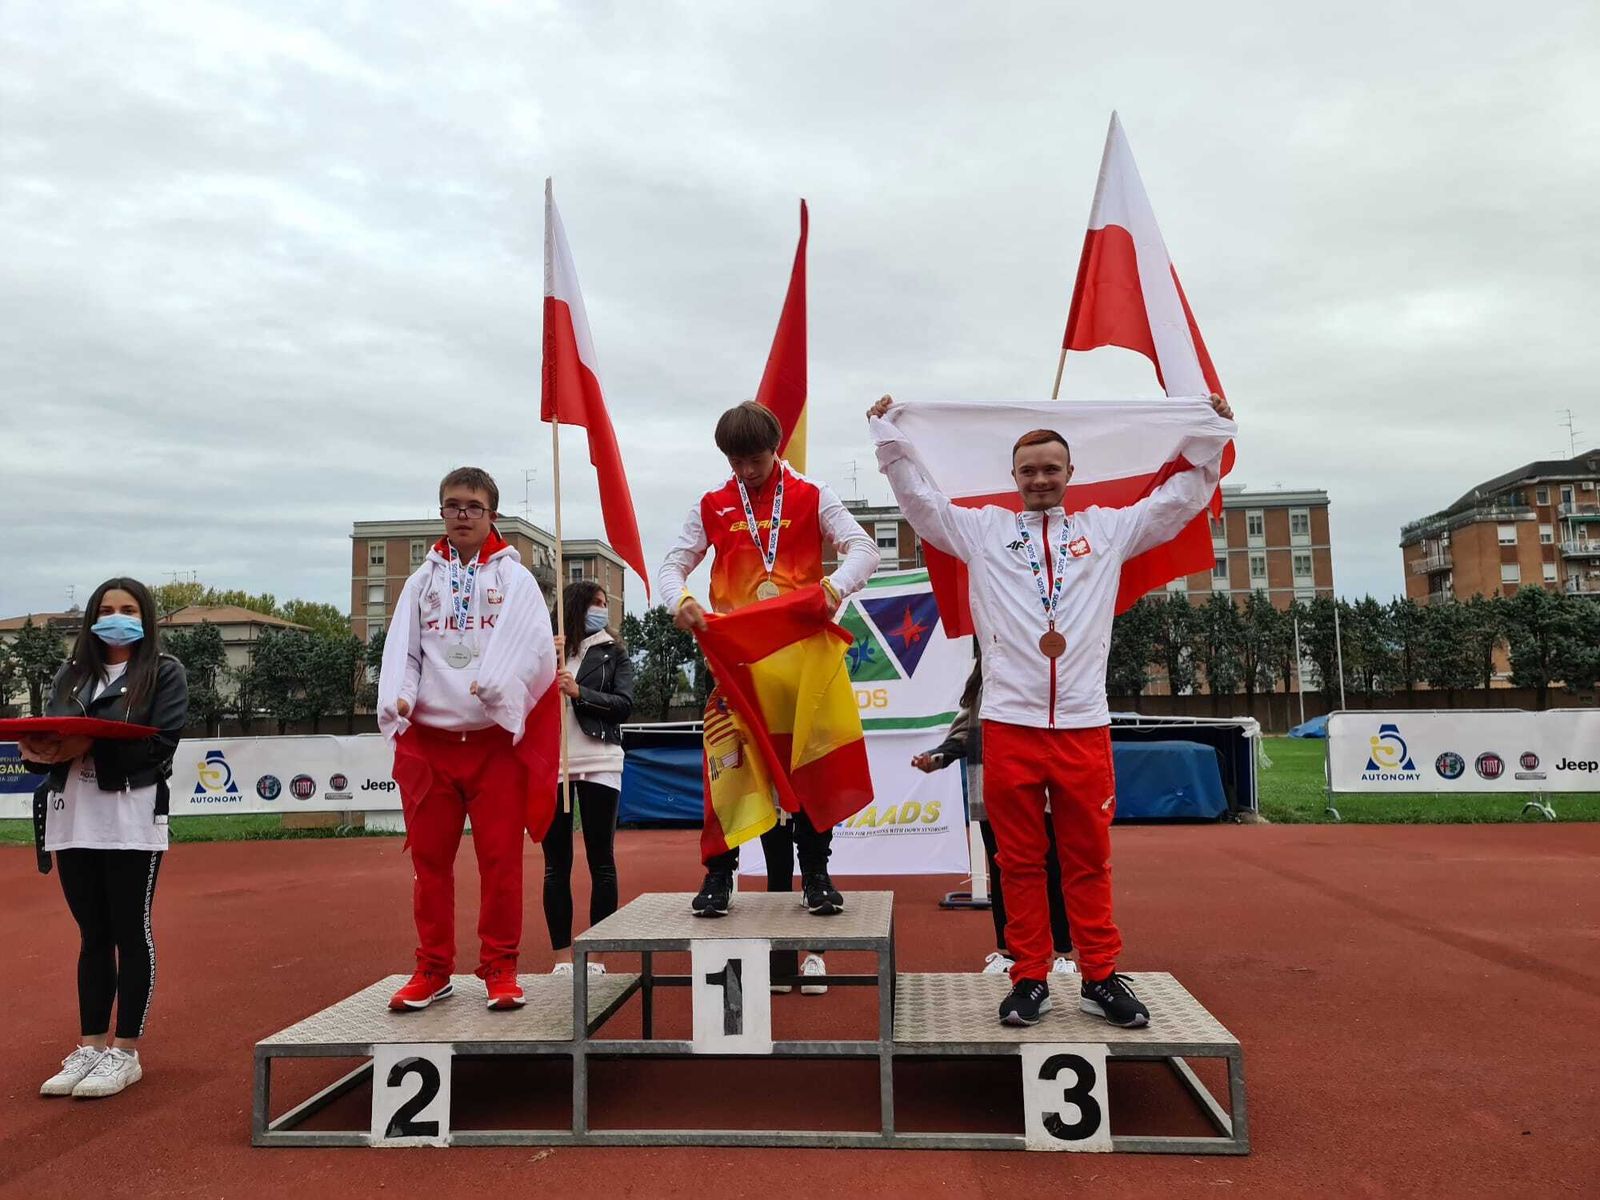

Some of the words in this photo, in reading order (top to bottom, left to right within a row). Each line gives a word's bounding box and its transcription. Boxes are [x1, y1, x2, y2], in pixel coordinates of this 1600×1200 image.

[729, 520, 791, 531] ESAA
[855, 688, 889, 709] DS
[1482, 760, 1499, 773] FIAT
[1555, 758, 1599, 773] Jeep
[1361, 773, 1421, 782] AUTONOMY
[296, 782, 311, 794] FIAT
[361, 779, 396, 793] Jeep
[190, 796, 243, 804] AUTONOMY
[706, 958, 743, 1036] 1
[385, 1057, 441, 1138] 2
[1038, 1053, 1101, 1140] 3
